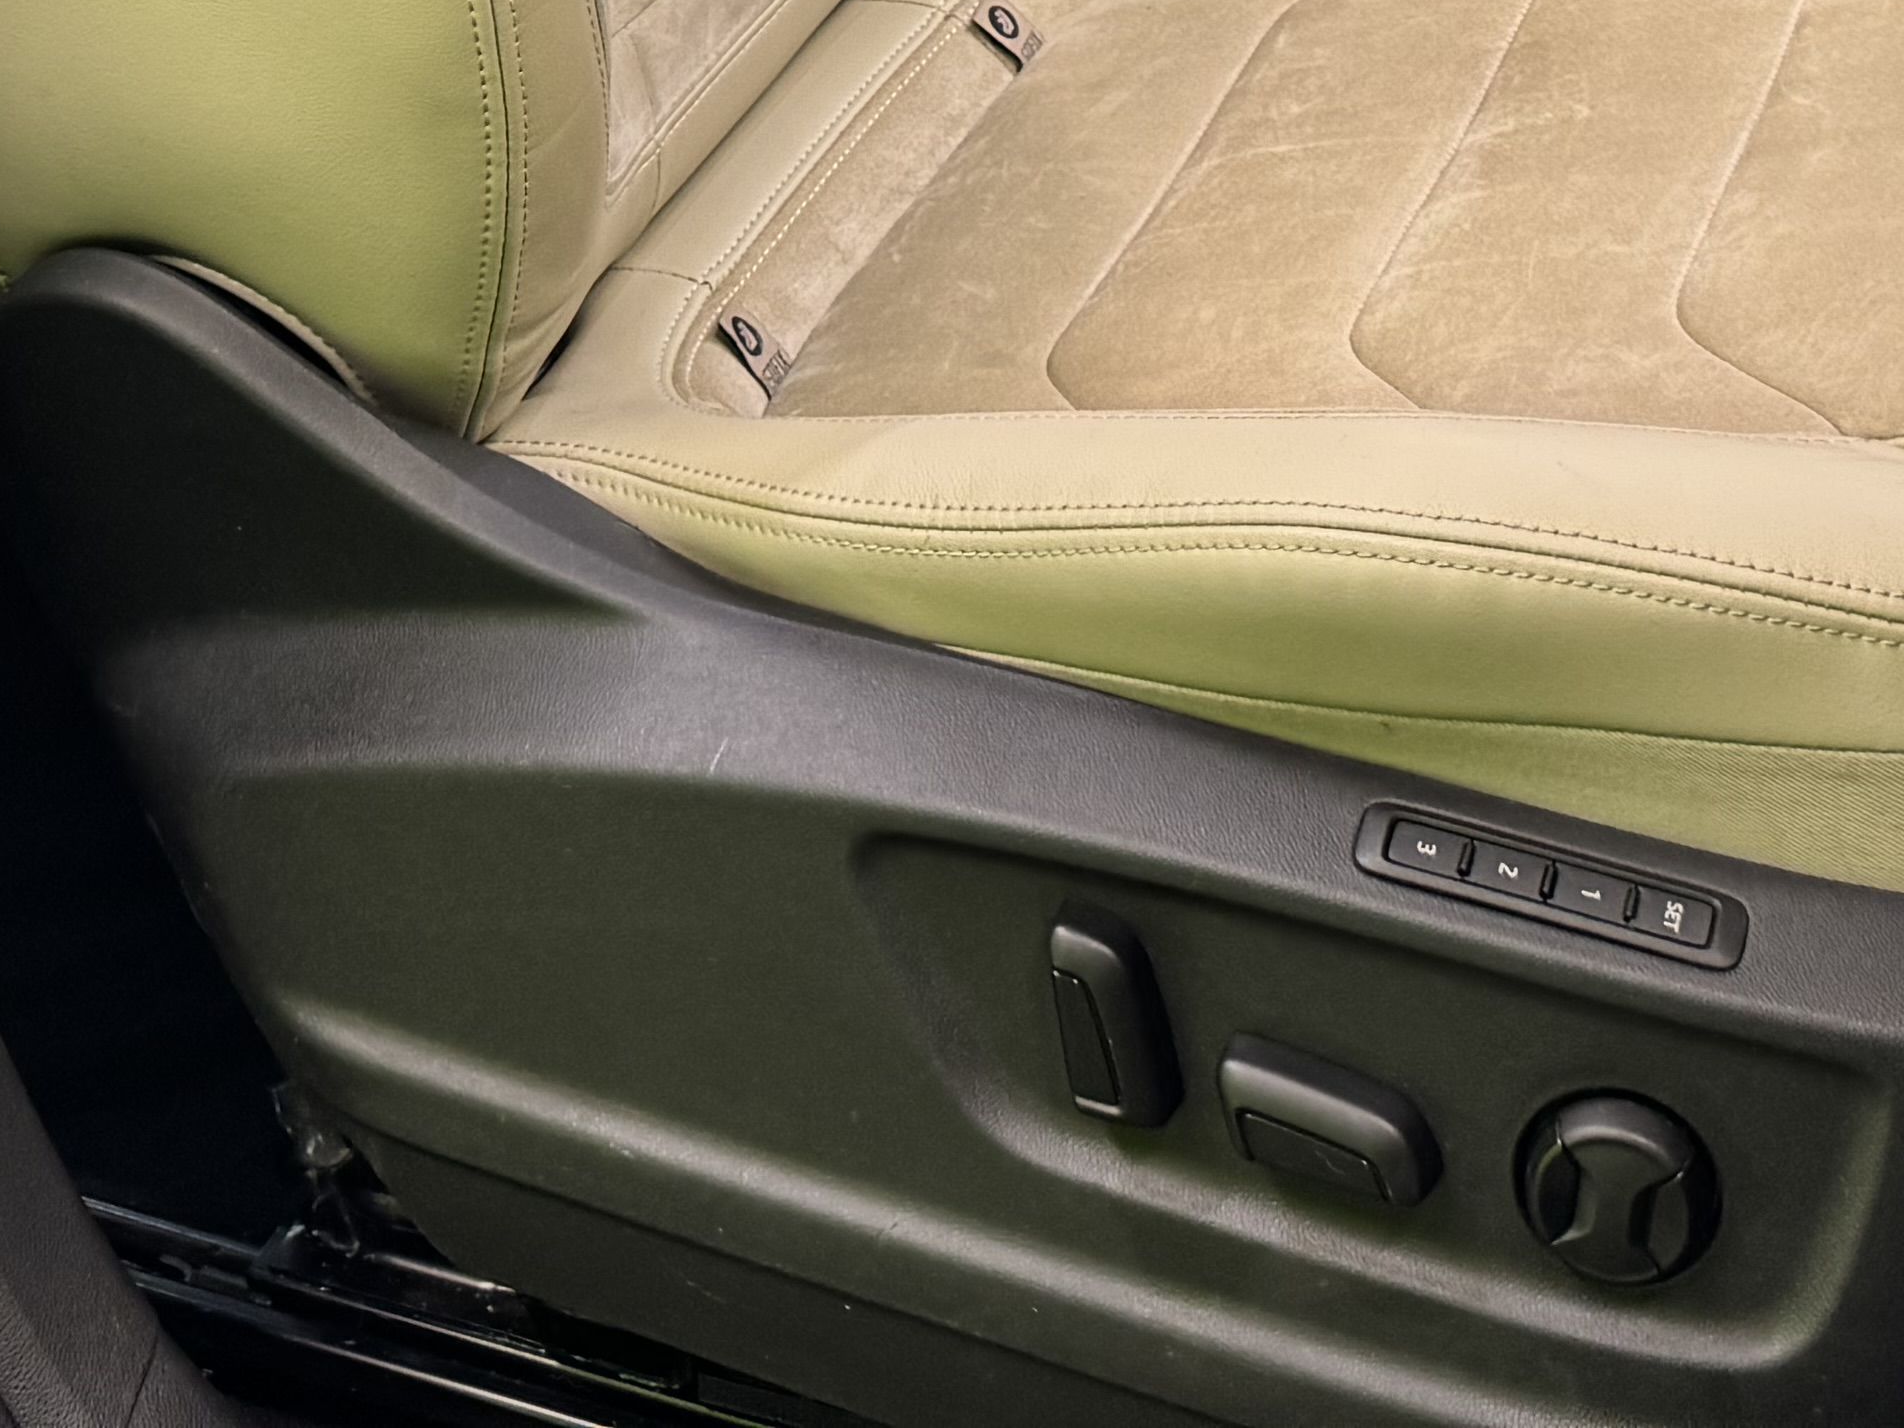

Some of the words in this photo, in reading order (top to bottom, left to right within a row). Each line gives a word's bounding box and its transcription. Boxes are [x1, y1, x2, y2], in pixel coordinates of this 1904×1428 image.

[1416, 840, 1436, 856] 3
[1498, 863, 1518, 879] 2
[1581, 889, 1601, 901] 1
[1663, 901, 1684, 933] SET
